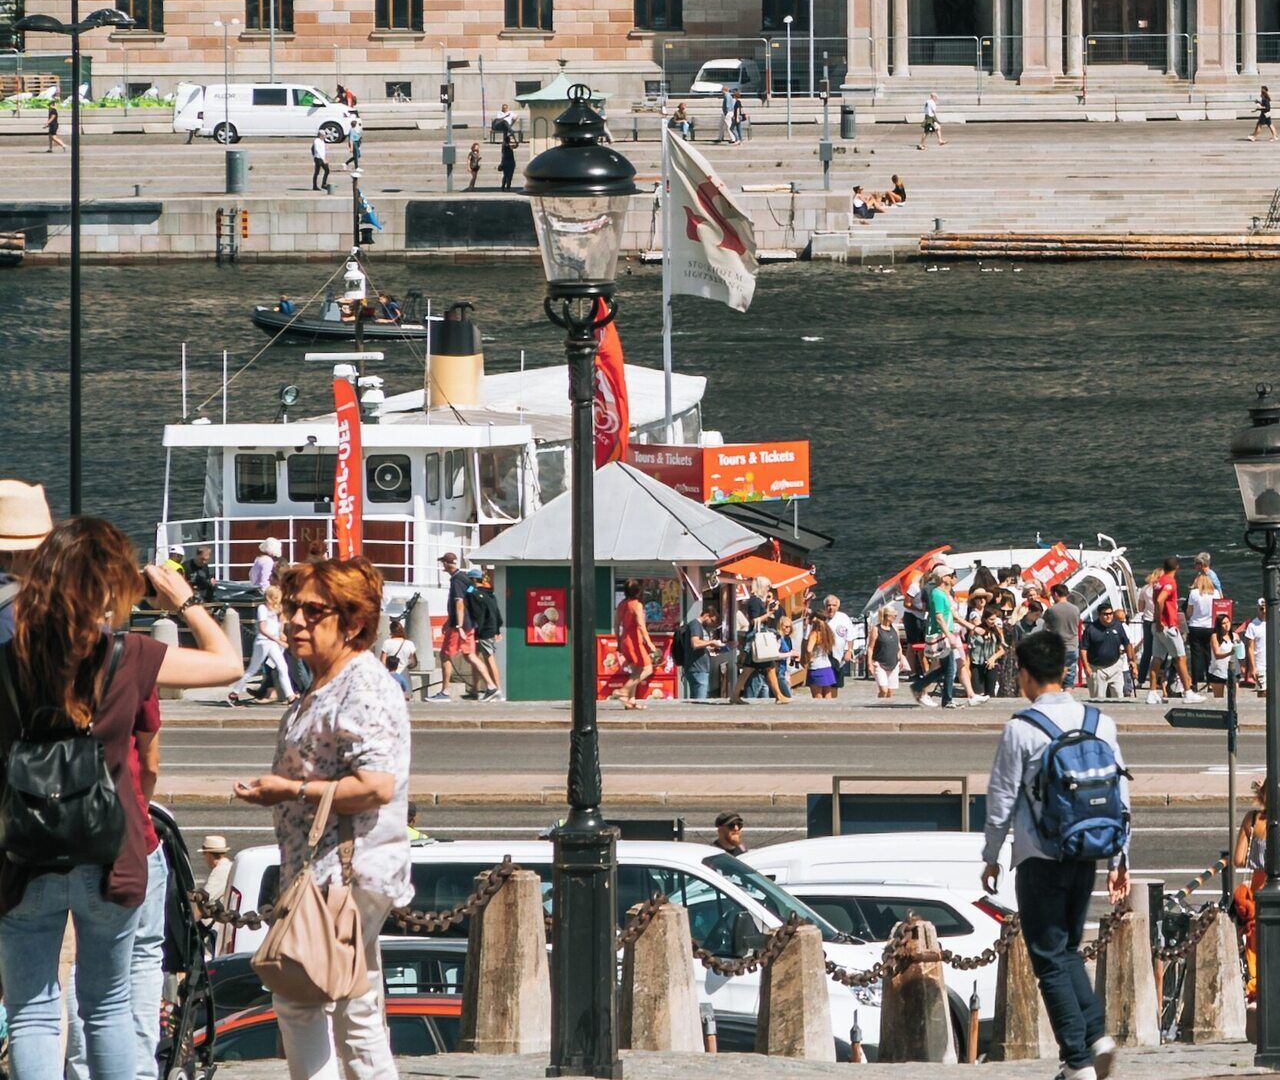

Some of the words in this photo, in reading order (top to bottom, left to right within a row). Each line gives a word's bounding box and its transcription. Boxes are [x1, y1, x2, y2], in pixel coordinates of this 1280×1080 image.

[634, 450, 655, 465] Tours
[657, 452, 663, 465] &
[665, 452, 693, 466] Tickets
[717, 453, 747, 466] Tours
[748, 451, 758, 464] &
[759, 450, 795, 464] Tickets
